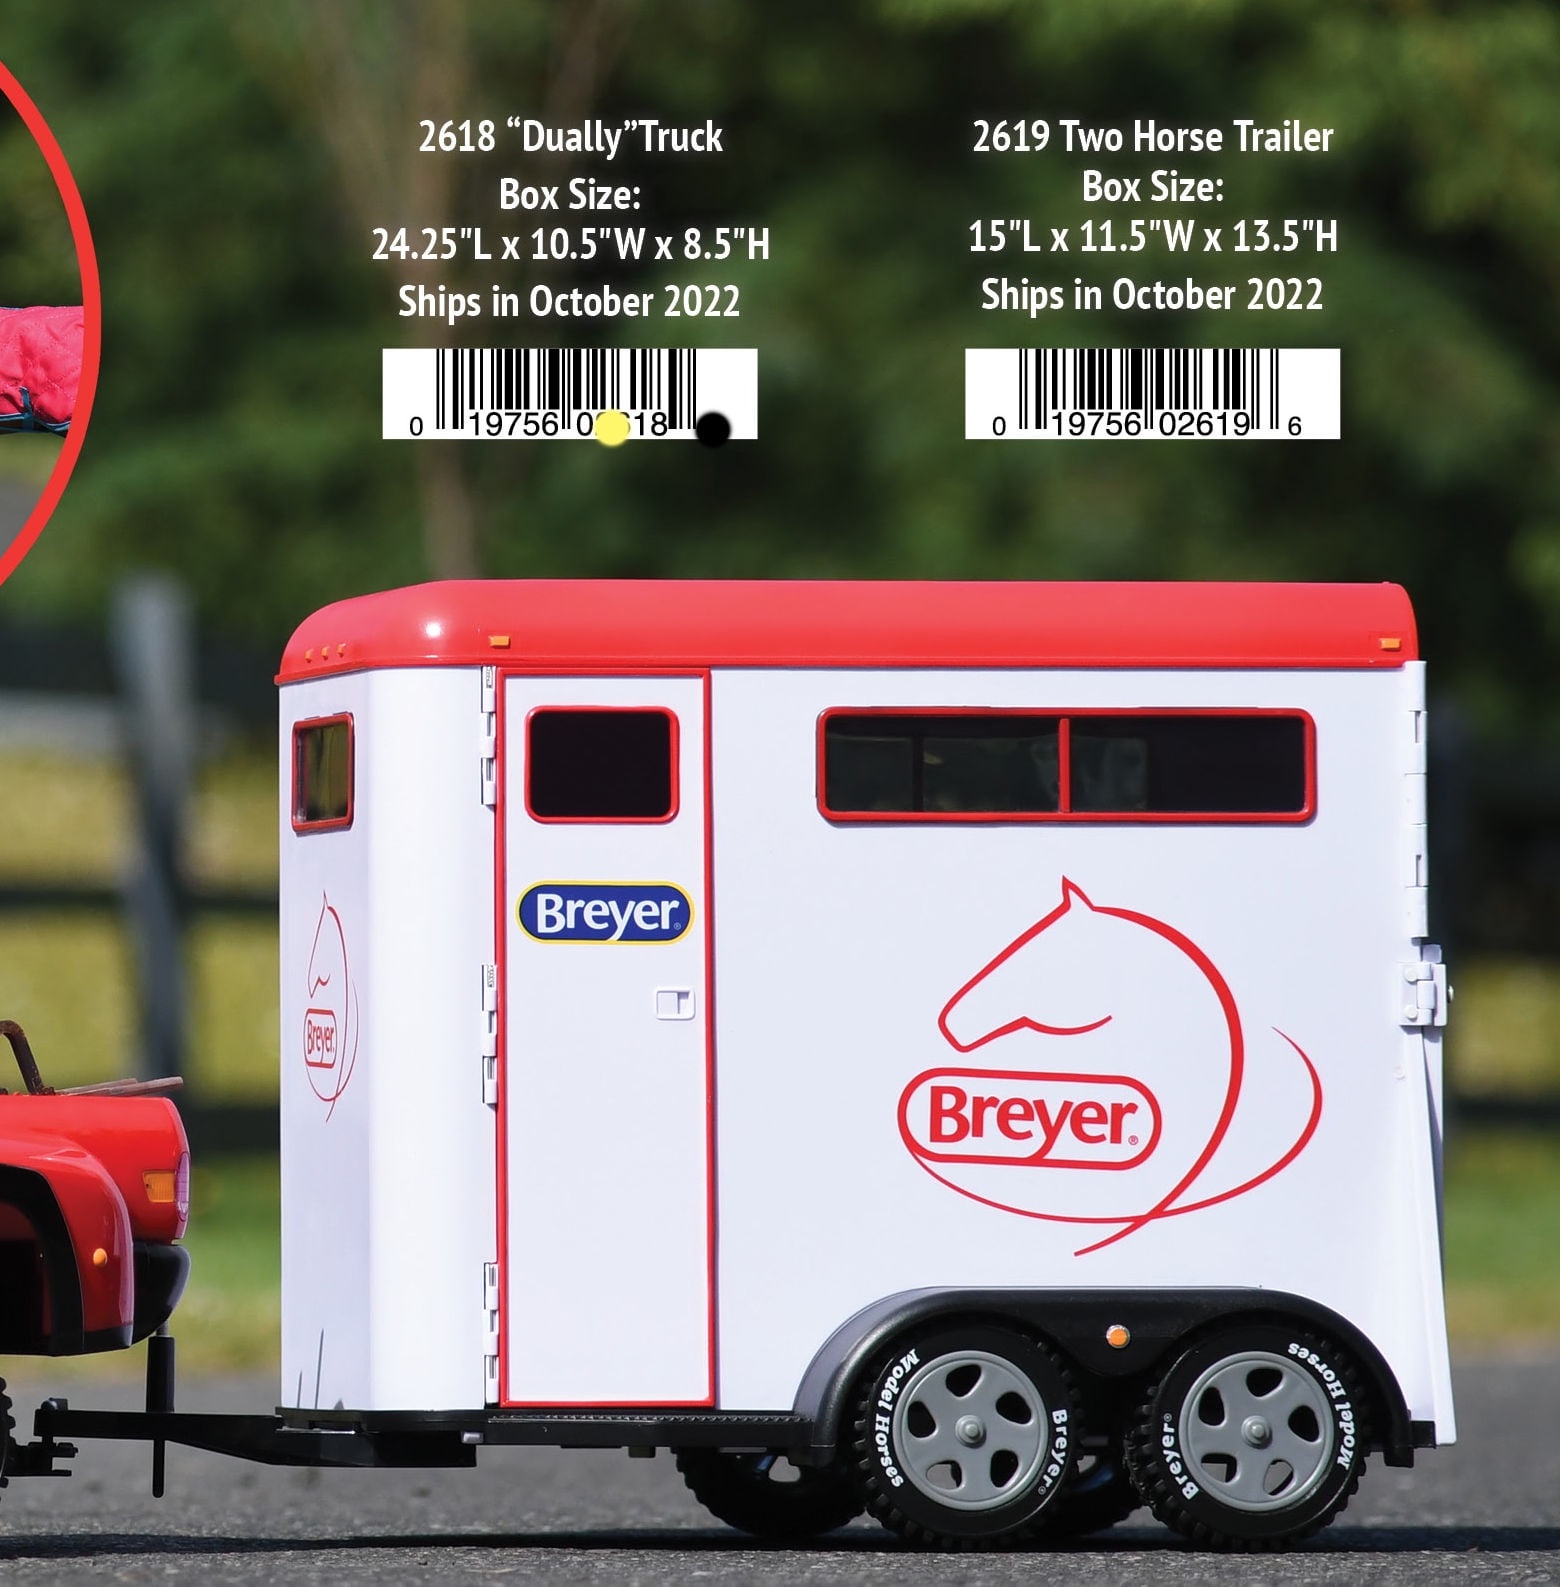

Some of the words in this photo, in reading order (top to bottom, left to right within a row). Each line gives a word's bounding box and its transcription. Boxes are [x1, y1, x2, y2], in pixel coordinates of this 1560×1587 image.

[877, 1348, 921, 1412] Model
[1287, 1342, 1347, 1399] Horses
[874, 1412, 905, 1488] Horses
[1334, 1401, 1356, 1471] Model
